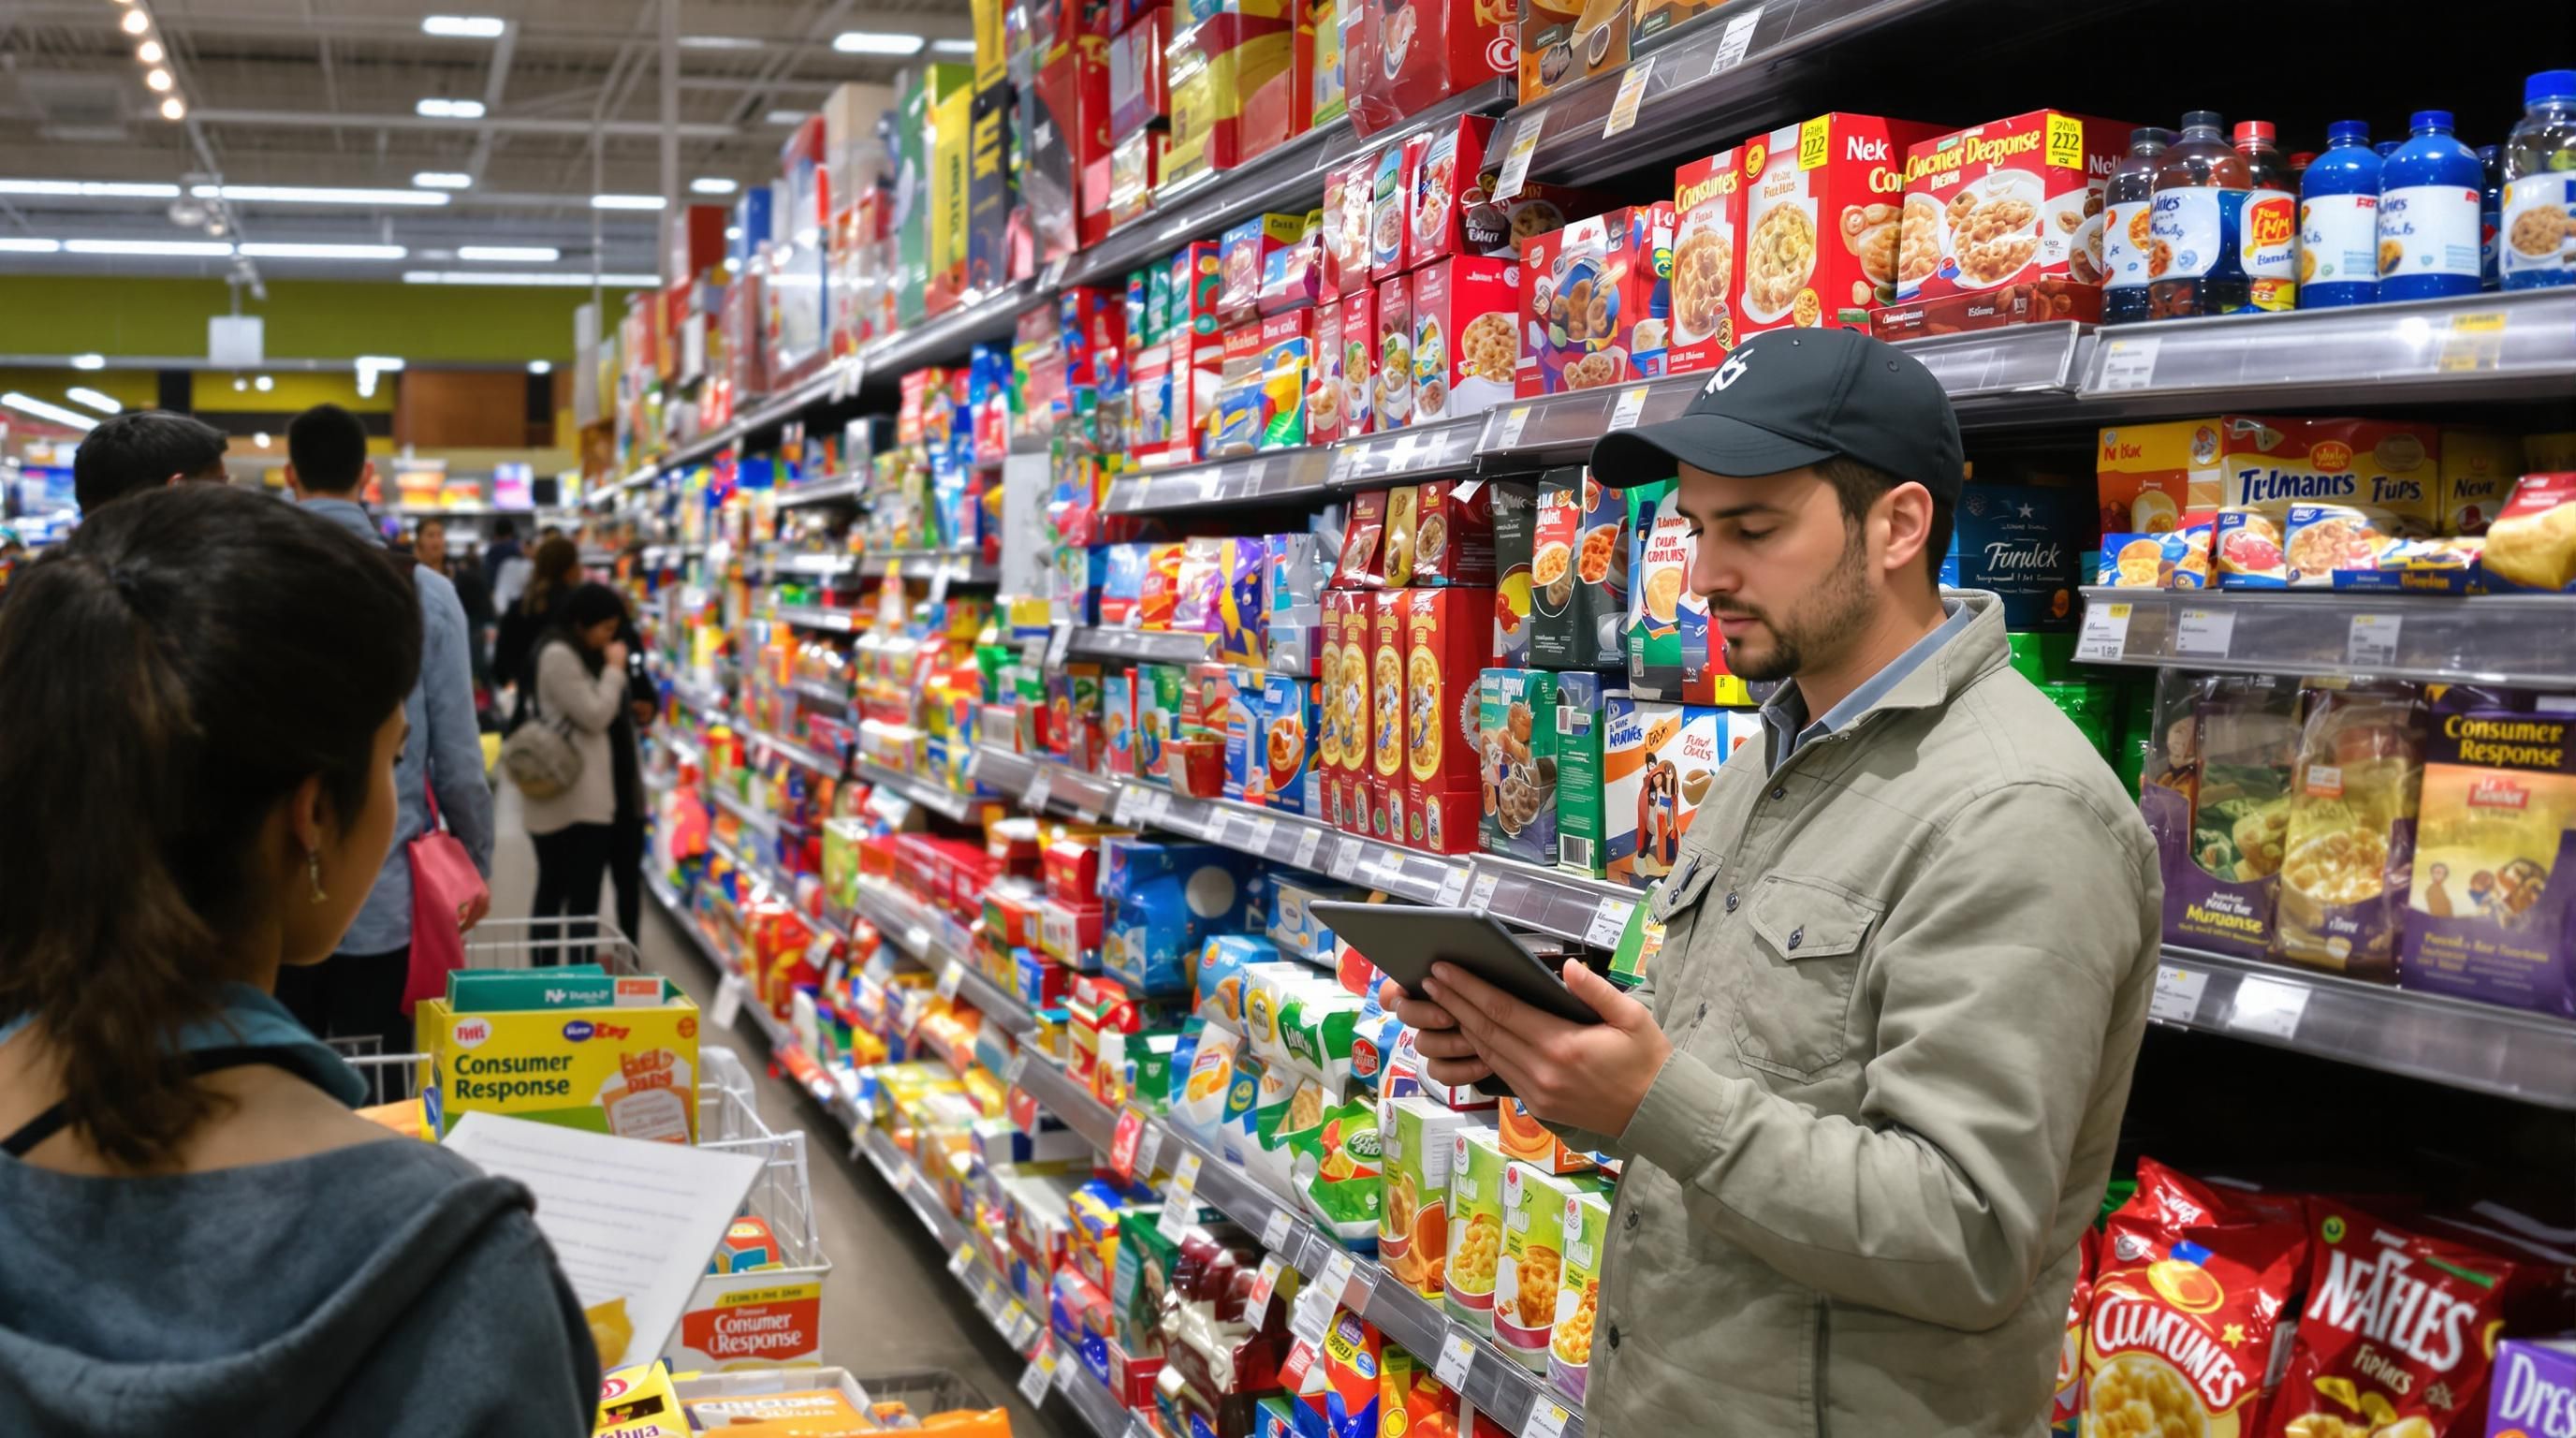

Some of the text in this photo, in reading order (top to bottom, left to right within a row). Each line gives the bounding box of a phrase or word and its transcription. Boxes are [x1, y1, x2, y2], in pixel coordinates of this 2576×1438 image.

[2444, 713, 2564, 743] Consumer
[2458, 739, 2564, 770] Response
[454, 1053, 574, 1076] Consumer
[456, 1078, 571, 1104] Response
